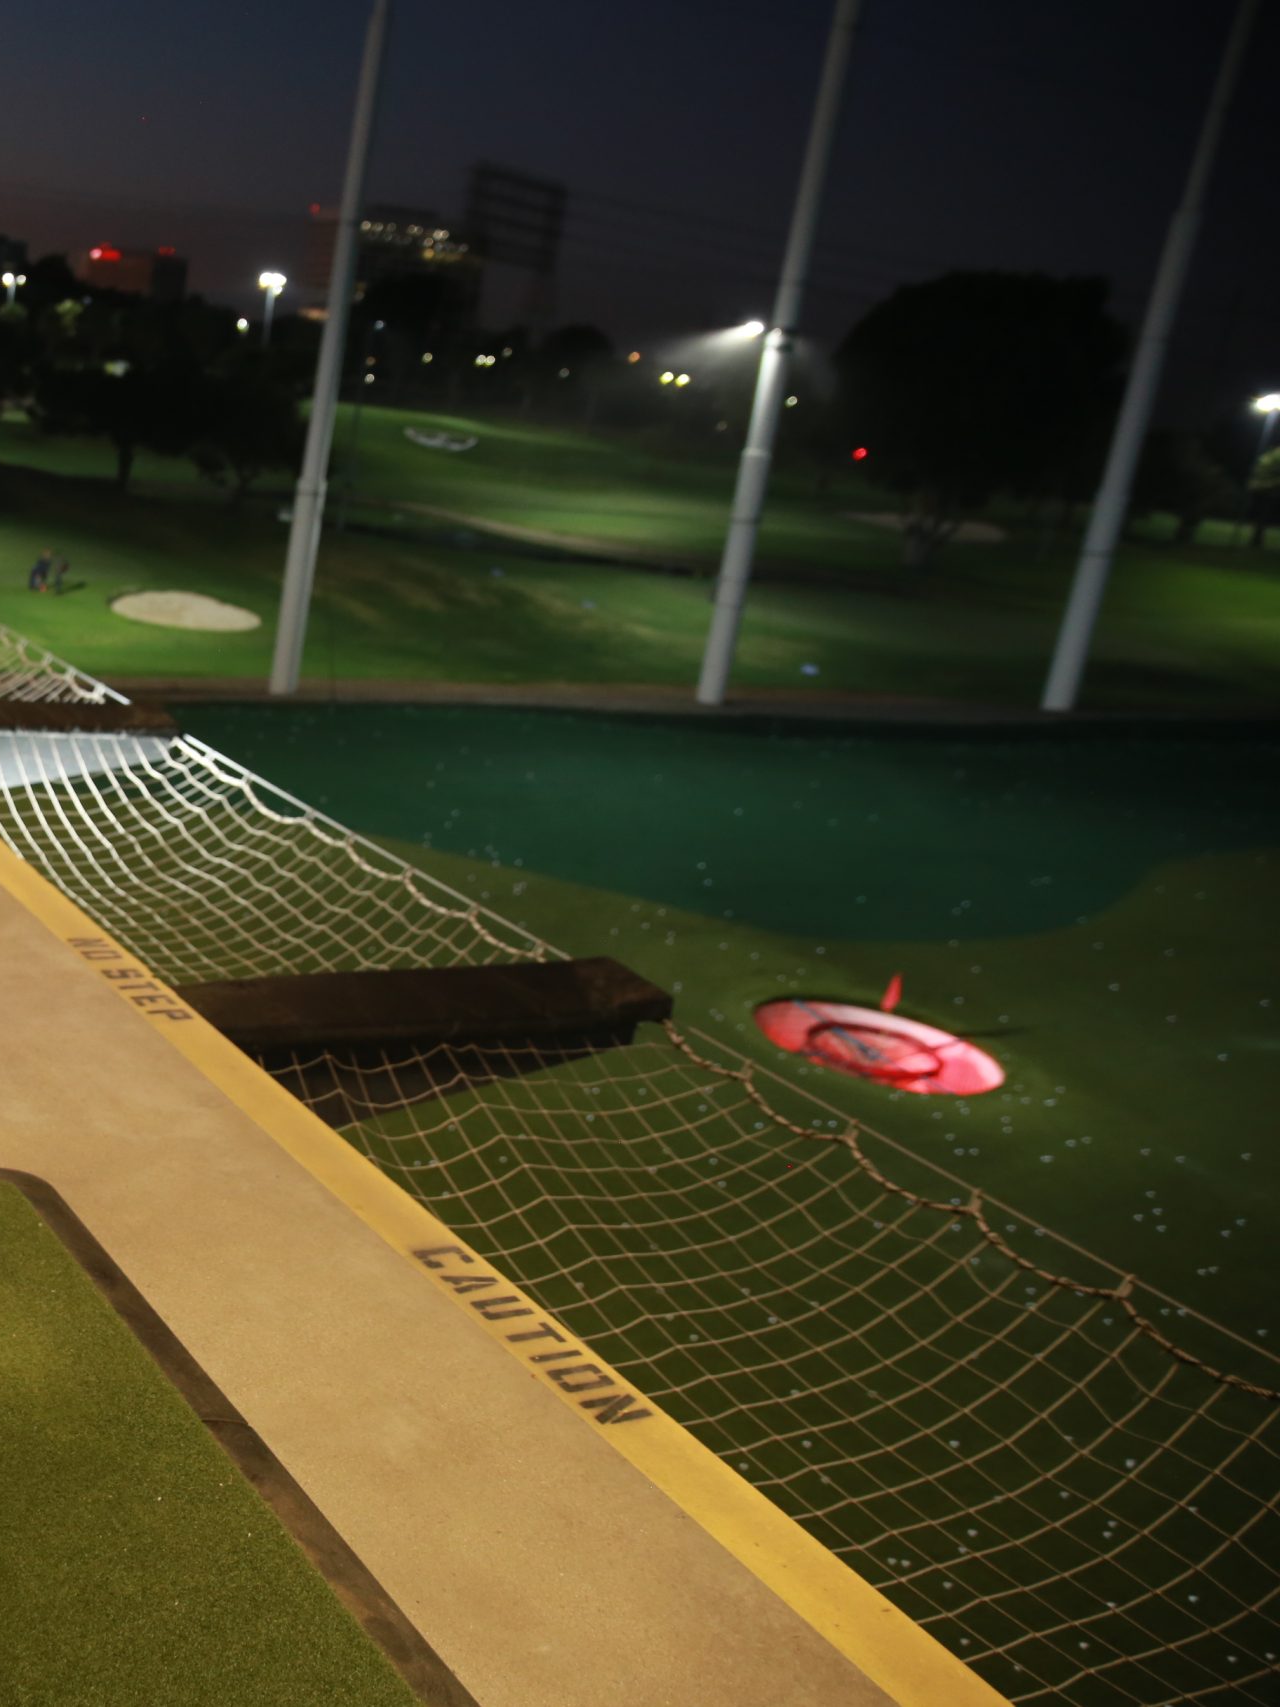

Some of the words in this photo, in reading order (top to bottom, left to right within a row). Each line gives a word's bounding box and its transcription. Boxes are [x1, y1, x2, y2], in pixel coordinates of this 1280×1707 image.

[66, 938, 123, 961] NO
[101, 967, 193, 1020] STEP
[413, 1245, 653, 1425] CAUTION
